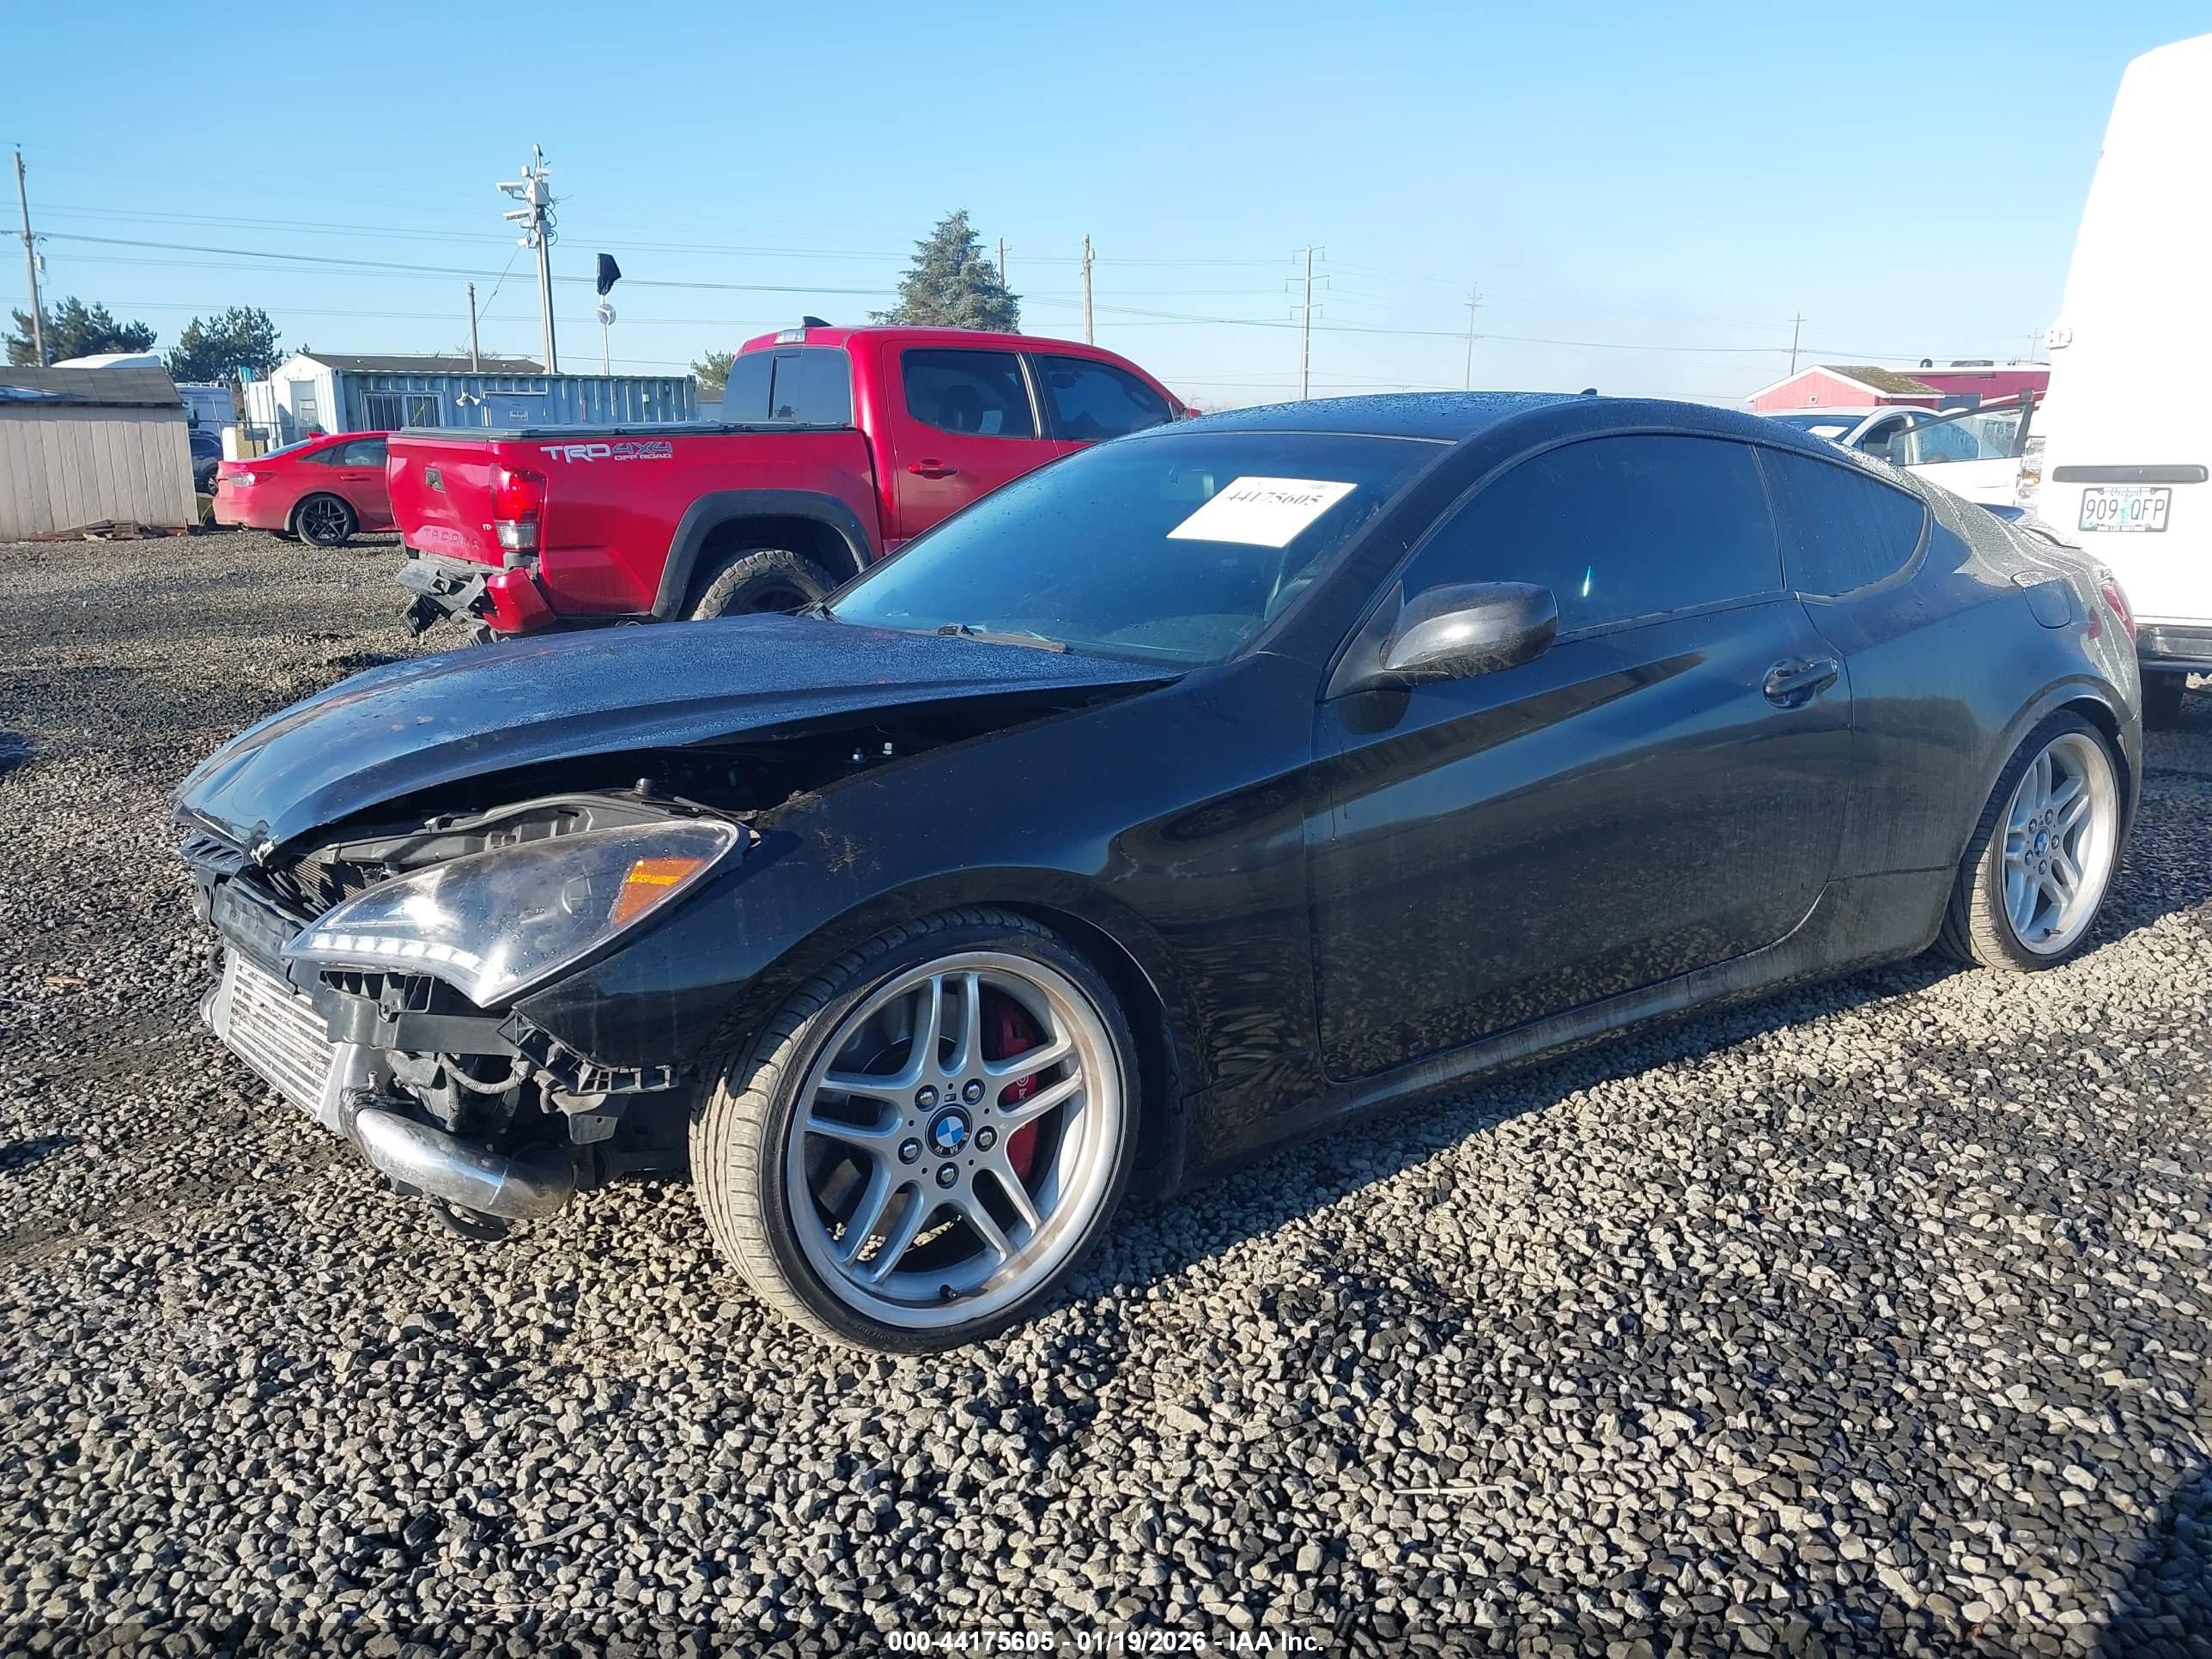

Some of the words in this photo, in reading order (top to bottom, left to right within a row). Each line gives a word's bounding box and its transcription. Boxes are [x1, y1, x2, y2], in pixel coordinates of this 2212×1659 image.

[539, 443, 611, 464] TRD
[1226, 490, 1324, 507] 44175605
[2086, 499, 2118, 520] 909
[2130, 499, 2165, 520] QFP
[934, 1132, 969, 1154] BMW
